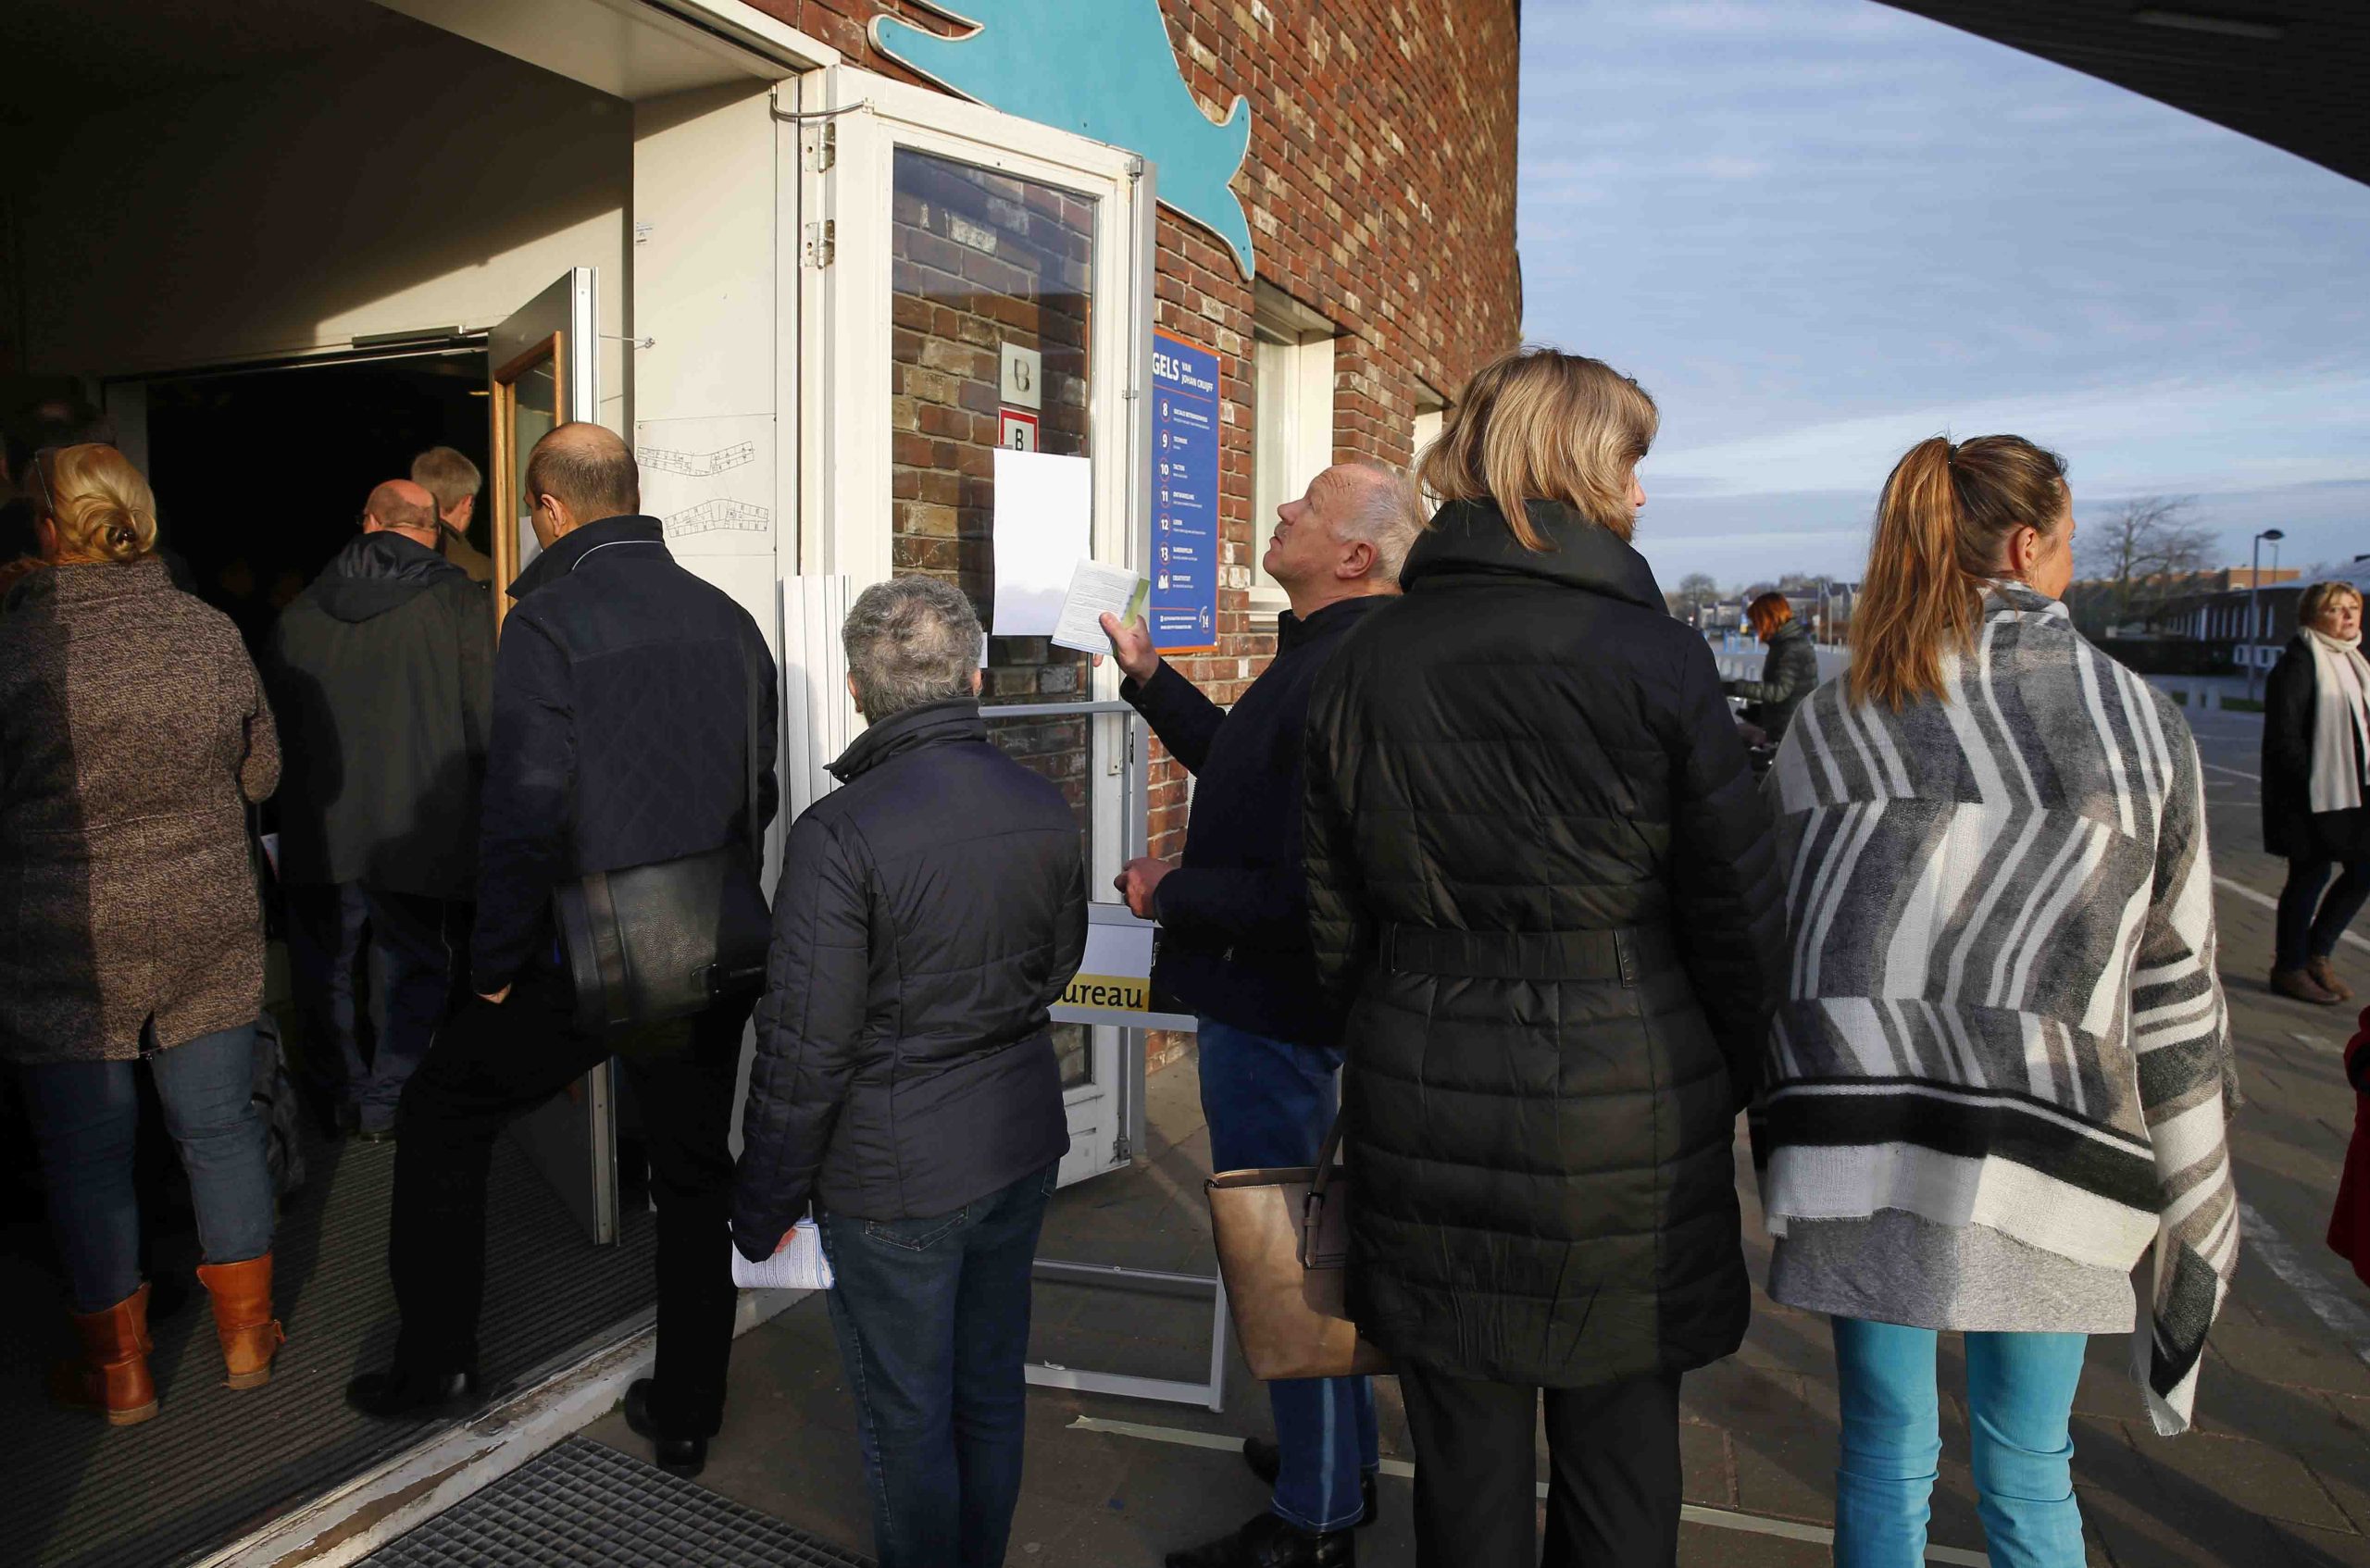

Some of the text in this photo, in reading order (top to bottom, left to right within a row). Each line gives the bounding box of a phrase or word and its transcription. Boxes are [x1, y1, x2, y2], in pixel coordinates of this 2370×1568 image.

[1162, 402, 1168, 417] 8
[1015, 428, 1024, 451] B
[1162, 433, 1168, 448] 9
[1160, 463, 1169, 476] 10
[1161, 490, 1168, 503] 11
[1161, 518, 1169, 530] 12
[1161, 547, 1168, 562] 13
[1202, 615, 1209, 628] 14
